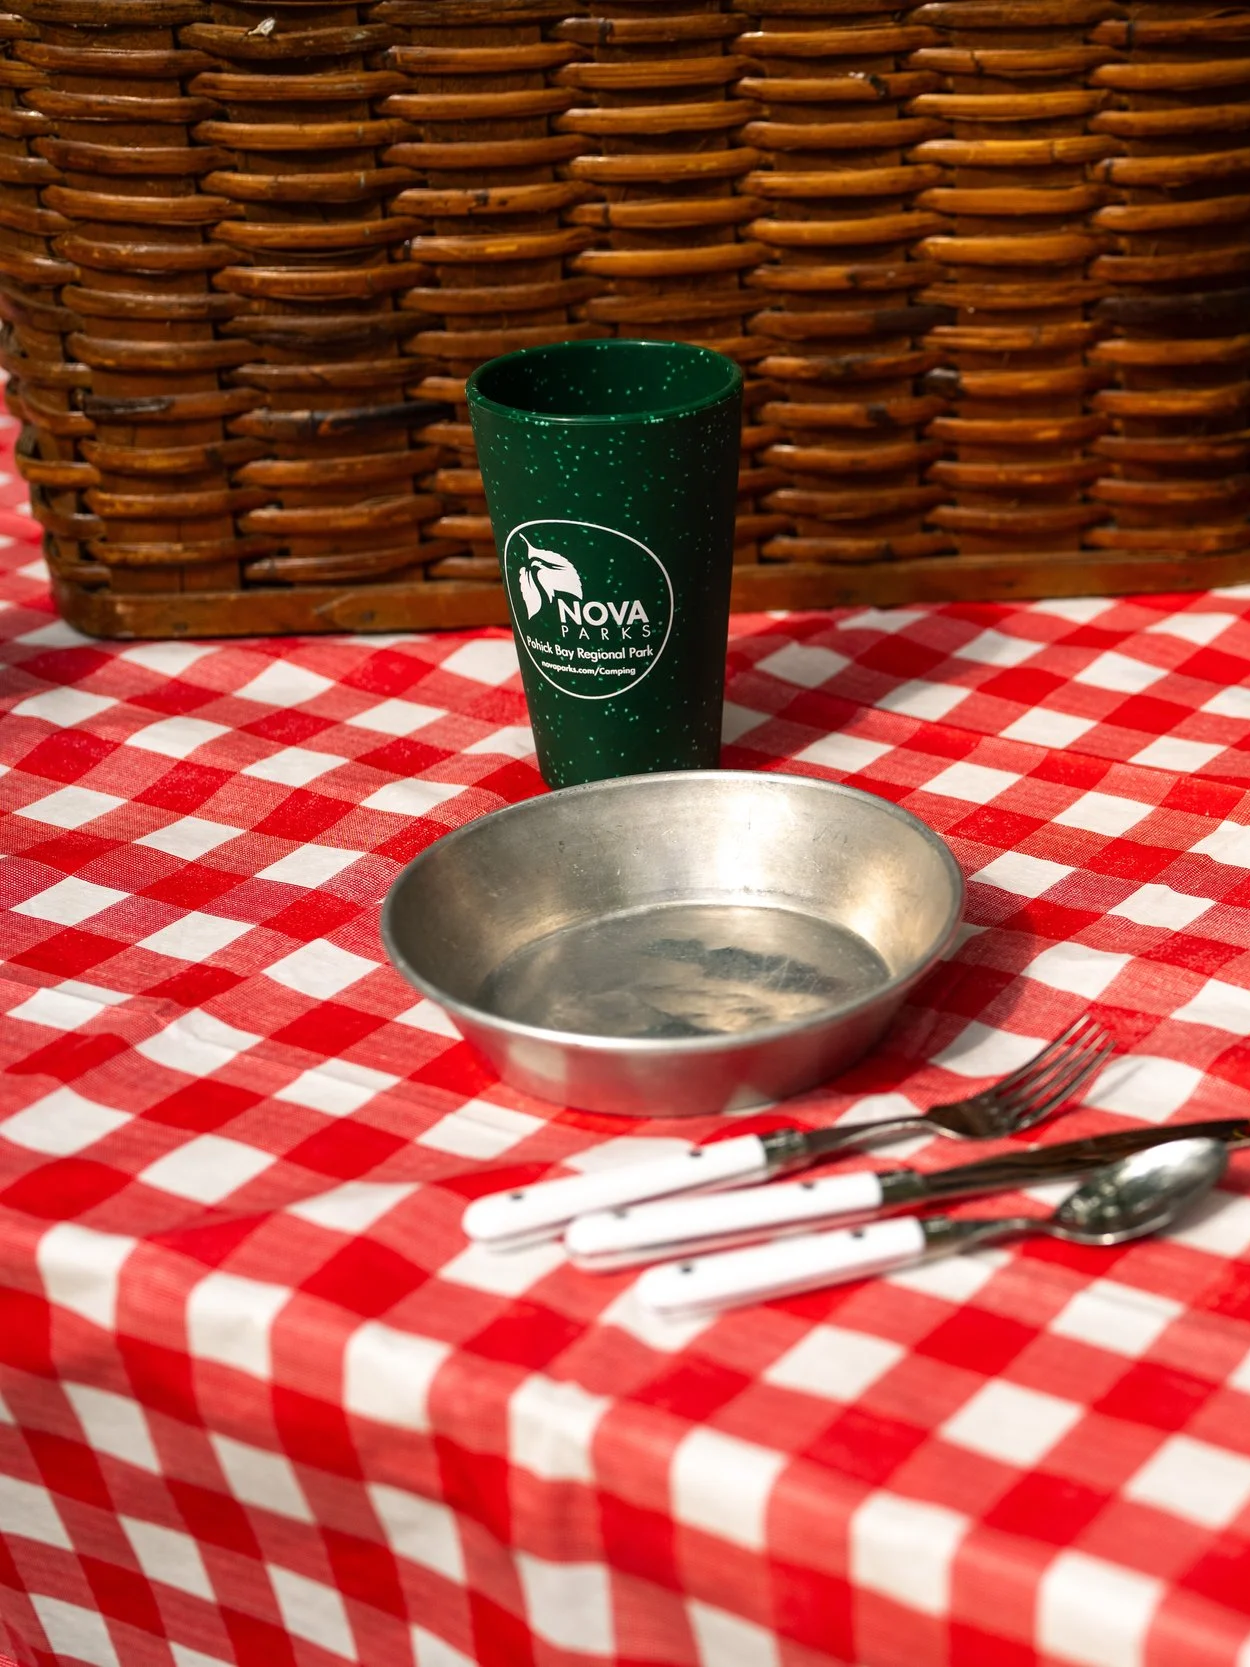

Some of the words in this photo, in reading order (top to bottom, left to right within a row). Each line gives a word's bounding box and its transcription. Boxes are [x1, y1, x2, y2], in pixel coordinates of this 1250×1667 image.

[557, 598, 650, 627] NOVA
[561, 624, 652, 640] PARKS
[526, 635, 554, 654] Pohick
[554, 644, 575, 660] Bay
[576, 647, 626, 662] Regional
[629, 644, 654, 658] Park
[541, 660, 636, 677] novaparks.com/Camping
